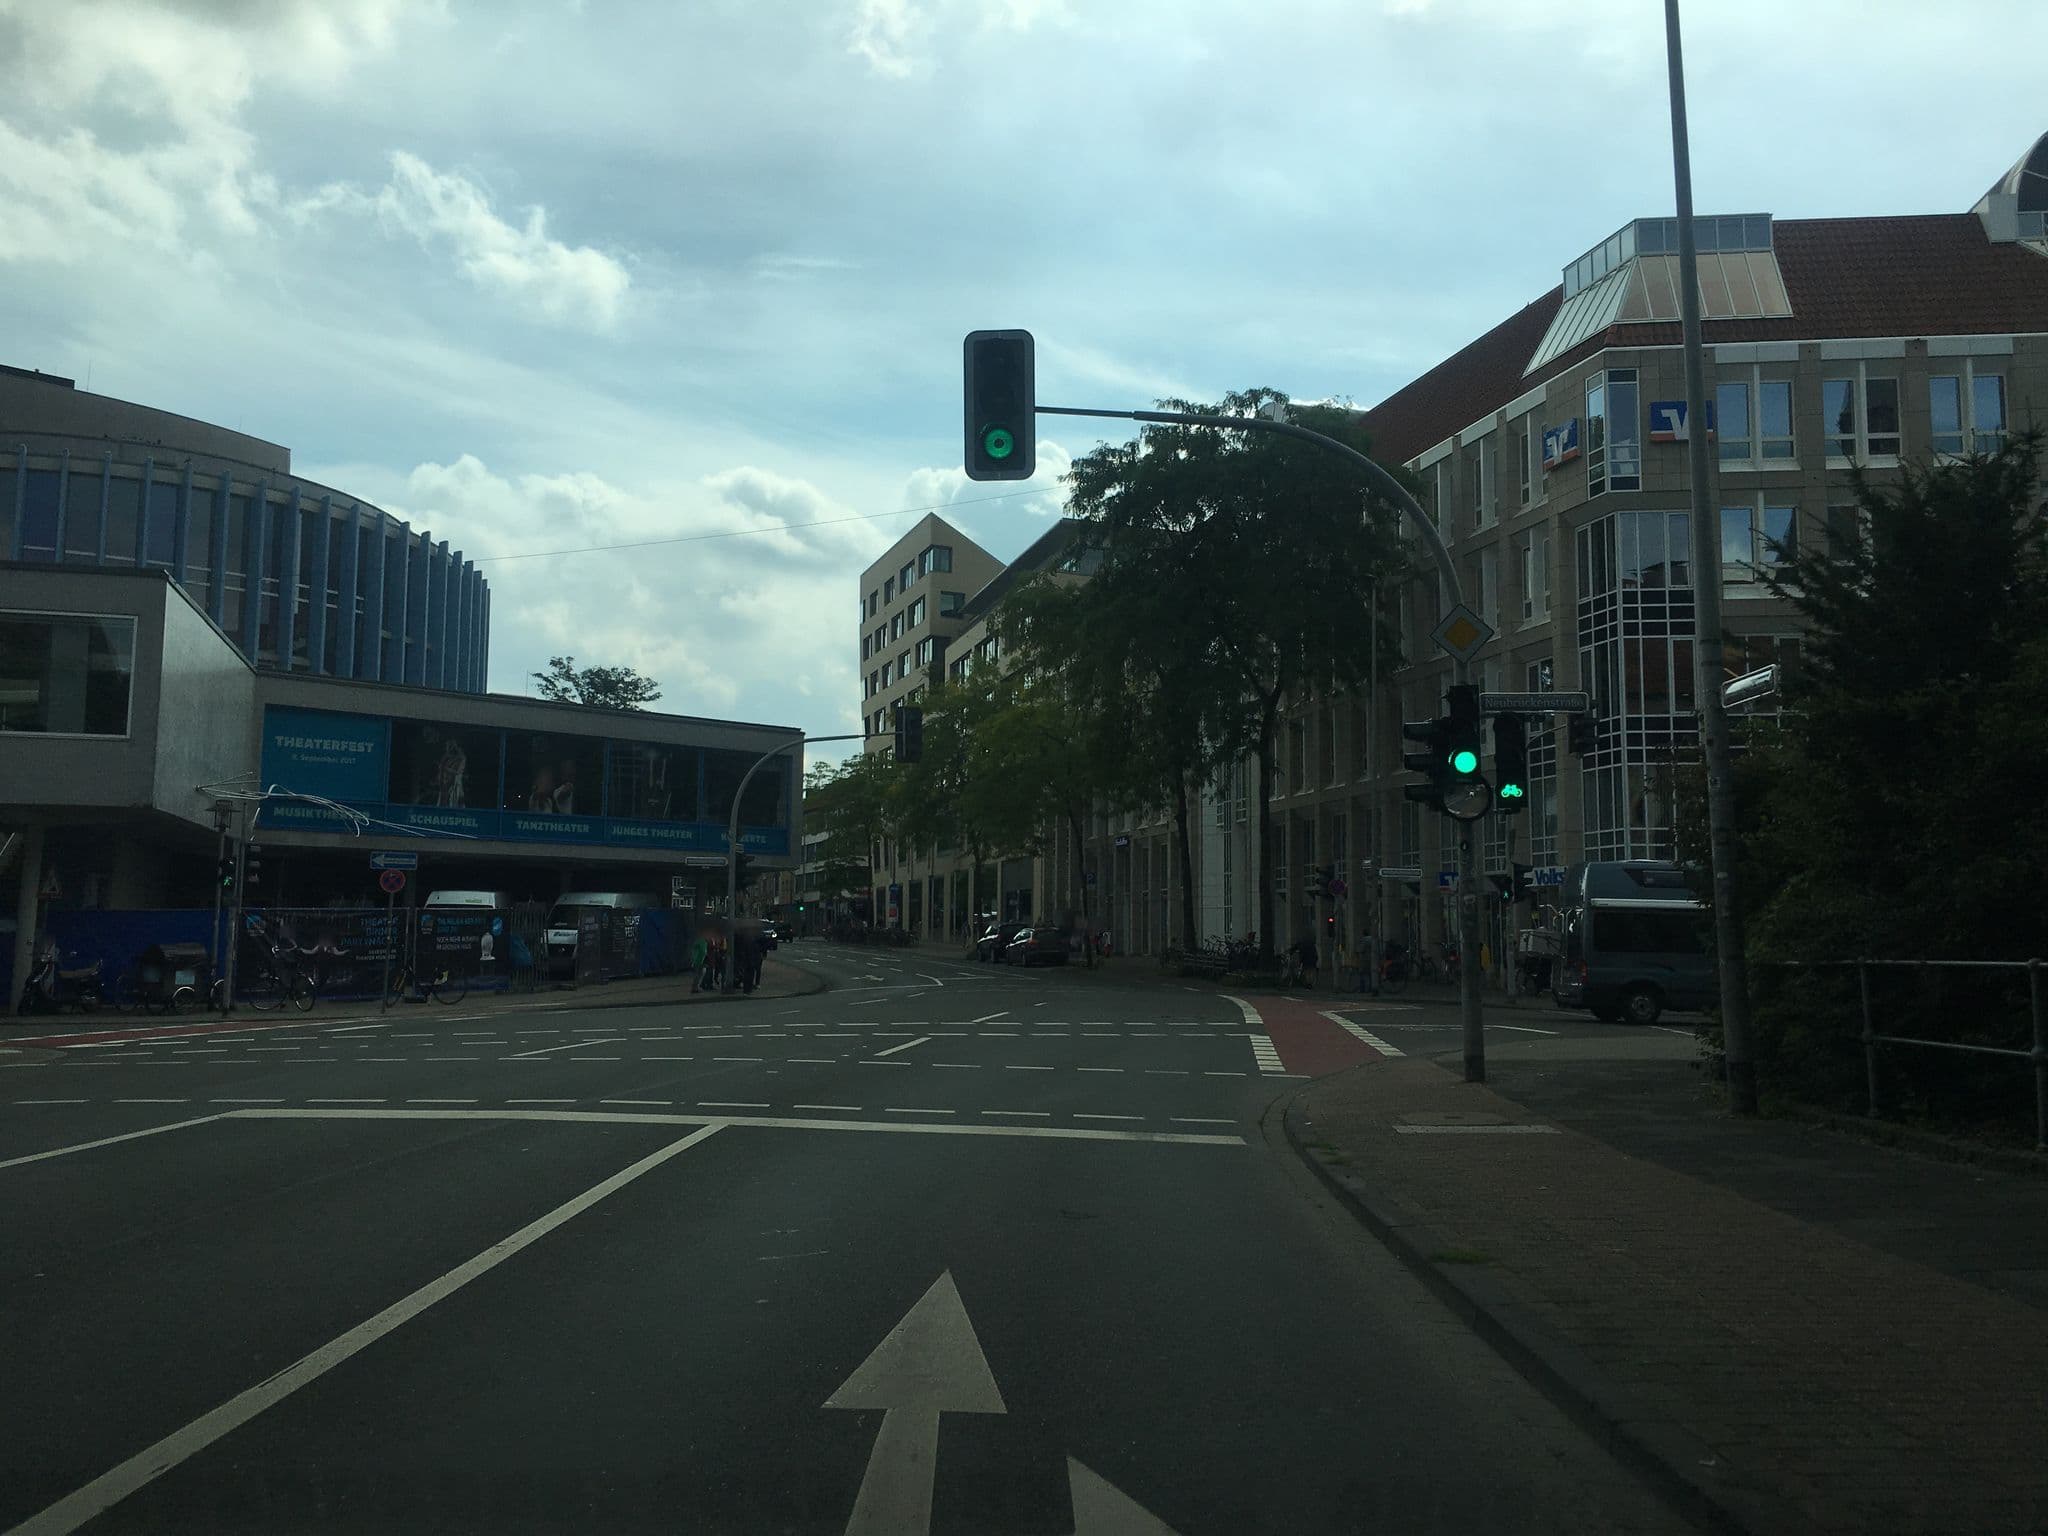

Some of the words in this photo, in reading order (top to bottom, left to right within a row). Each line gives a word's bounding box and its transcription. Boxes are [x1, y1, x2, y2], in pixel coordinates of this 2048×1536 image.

[274, 735, 374, 753] THEATERFEST
[408, 813, 479, 828] SCHAUSPIEL
[516, 820, 590, 834] TANZTHEATER
[611, 825, 649, 837] JUNGES
[651, 828, 693, 840] THEATER
[720, 831, 767, 844] KZERTE
